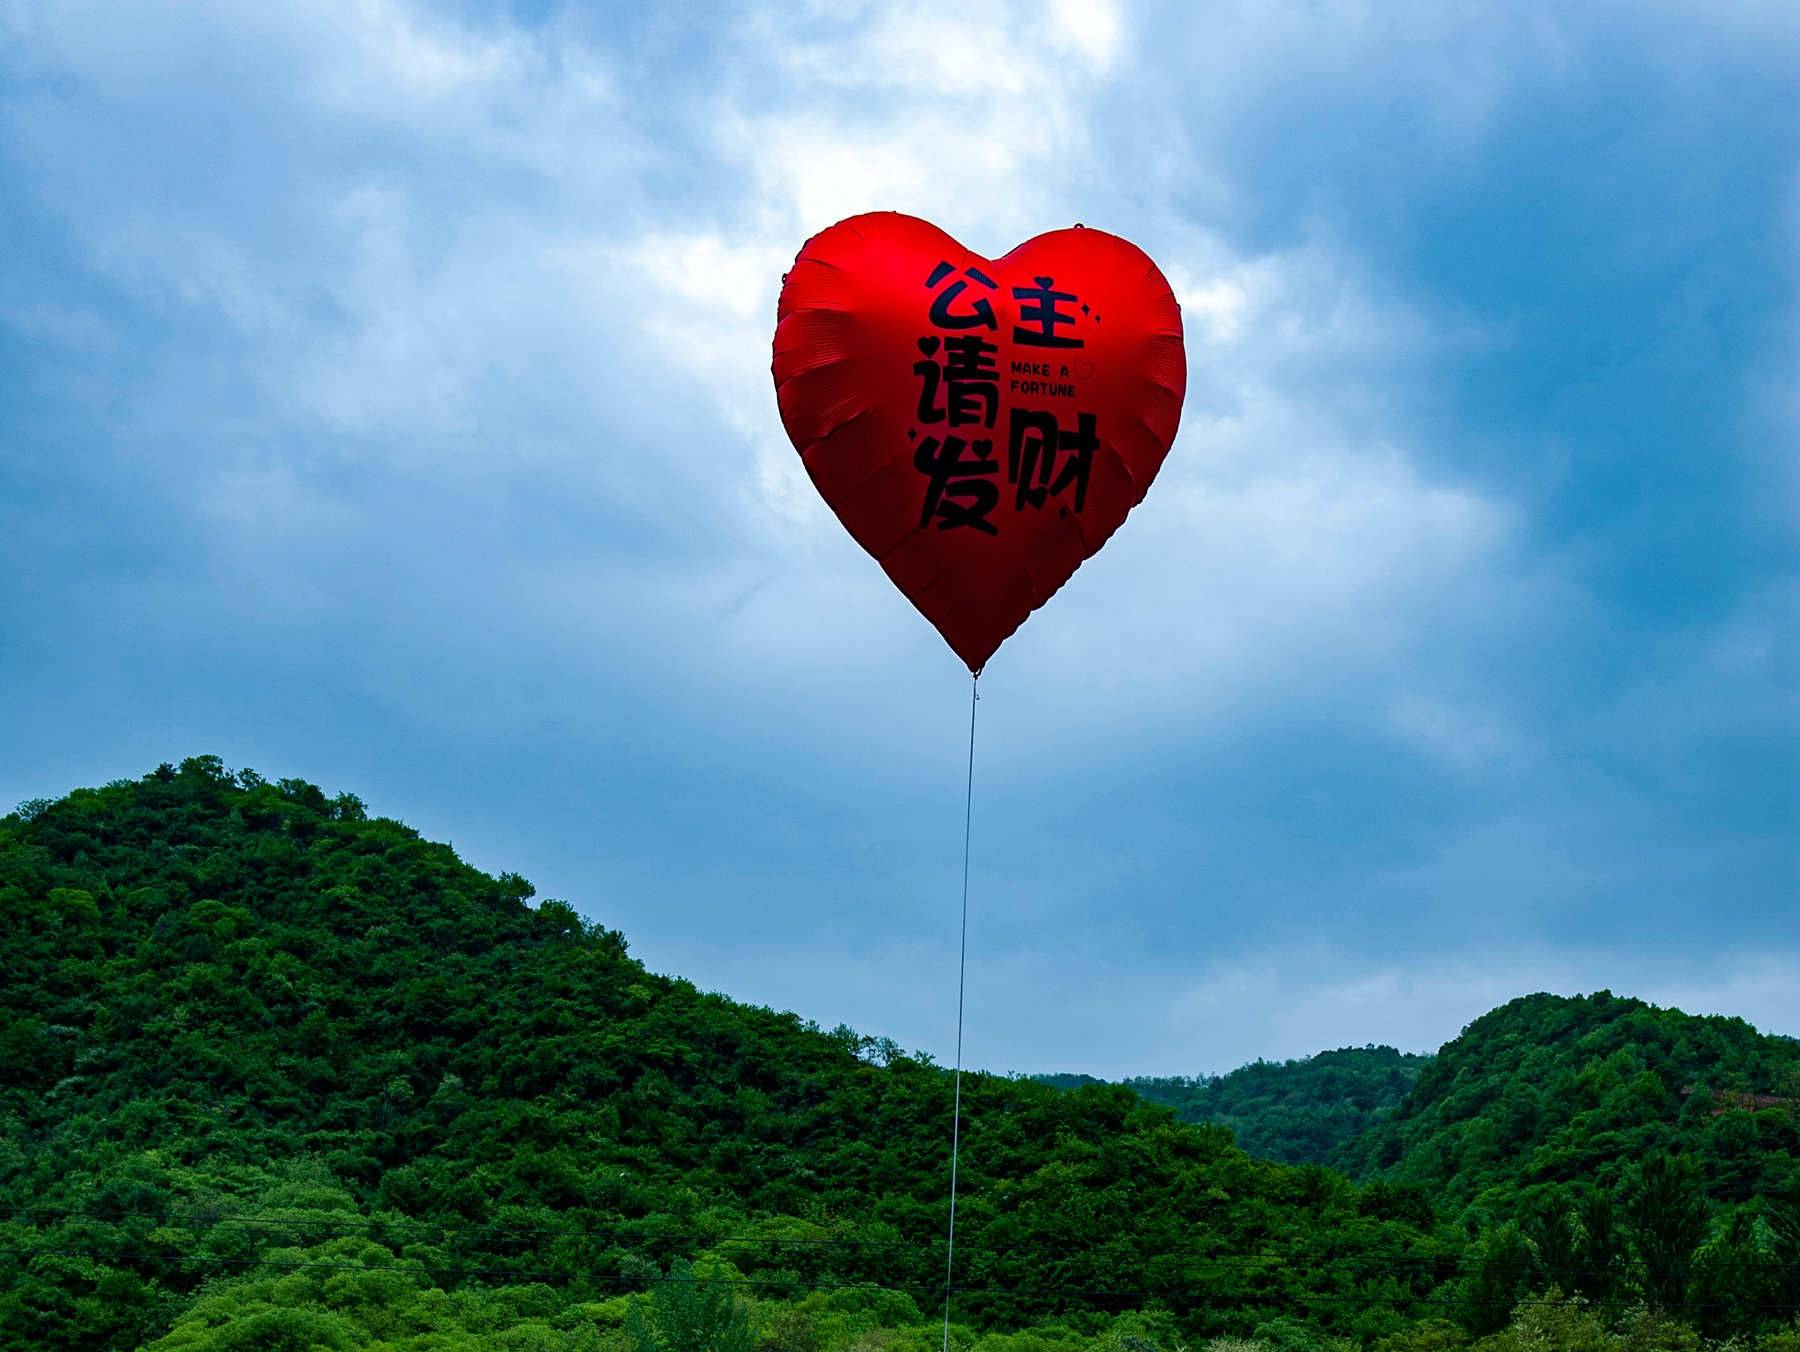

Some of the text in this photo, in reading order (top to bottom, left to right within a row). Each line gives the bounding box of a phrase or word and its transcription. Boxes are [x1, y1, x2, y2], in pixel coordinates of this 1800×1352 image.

[925, 260, 1085, 349] 公主
[912, 335, 1000, 429] 请
[1010, 361, 1070, 378] MAKE A
[1010, 380, 1077, 398] FORTUNE
[912, 407, 1101, 537] 发财
